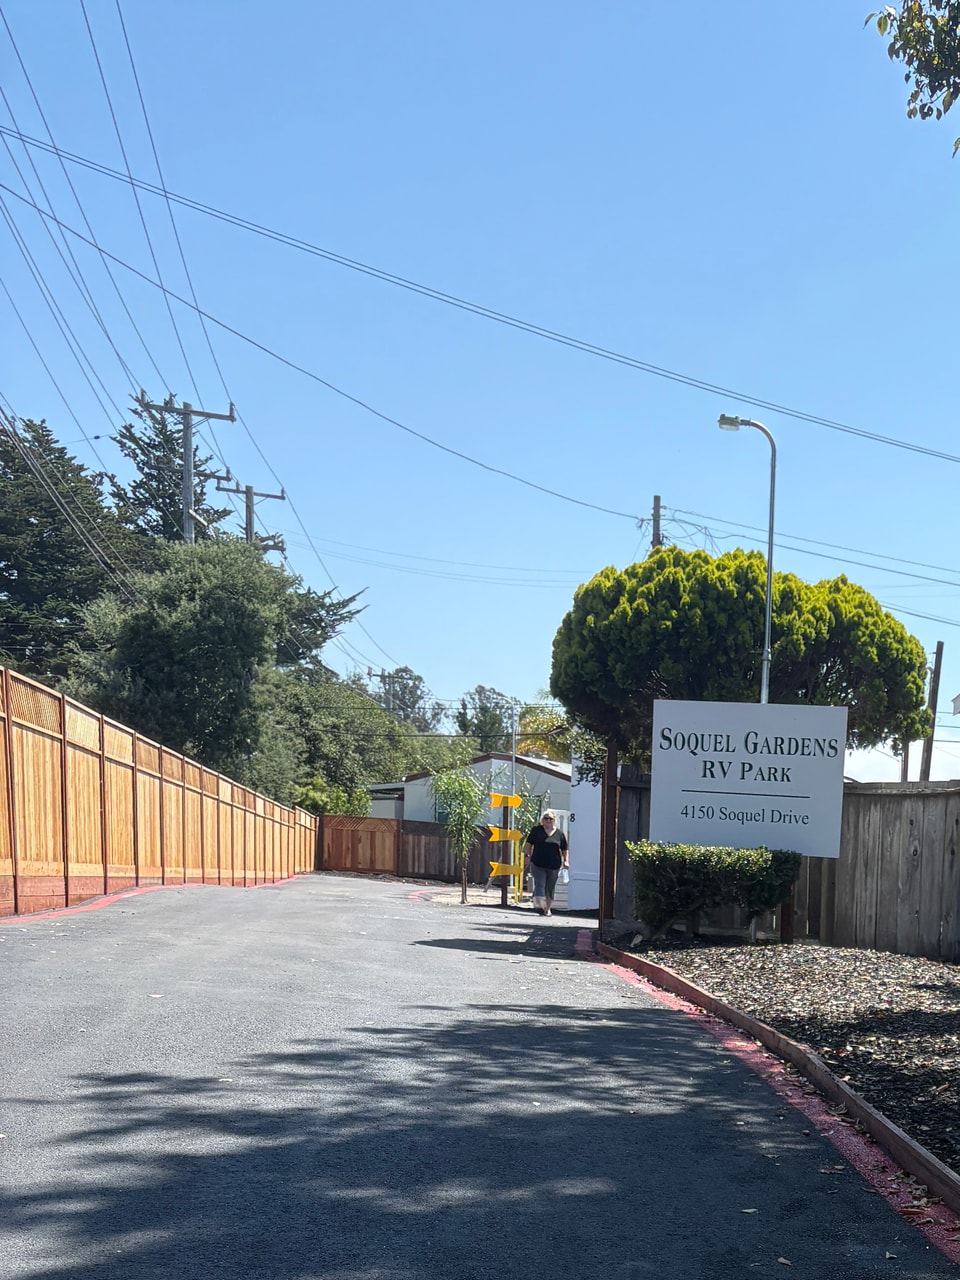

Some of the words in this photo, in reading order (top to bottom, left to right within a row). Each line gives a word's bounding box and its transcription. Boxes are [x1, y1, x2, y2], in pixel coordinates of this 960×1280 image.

[659, 727, 736, 756] SOQUEL
[744, 731, 838, 758] GARDENS
[701, 760, 732, 779] RV
[739, 762, 792, 782] PARK
[570, 813, 575, 822] 8
[680, 805, 714, 820] 4150
[719, 807, 765, 825] Soquel
[770, 810, 809, 825] Drive
